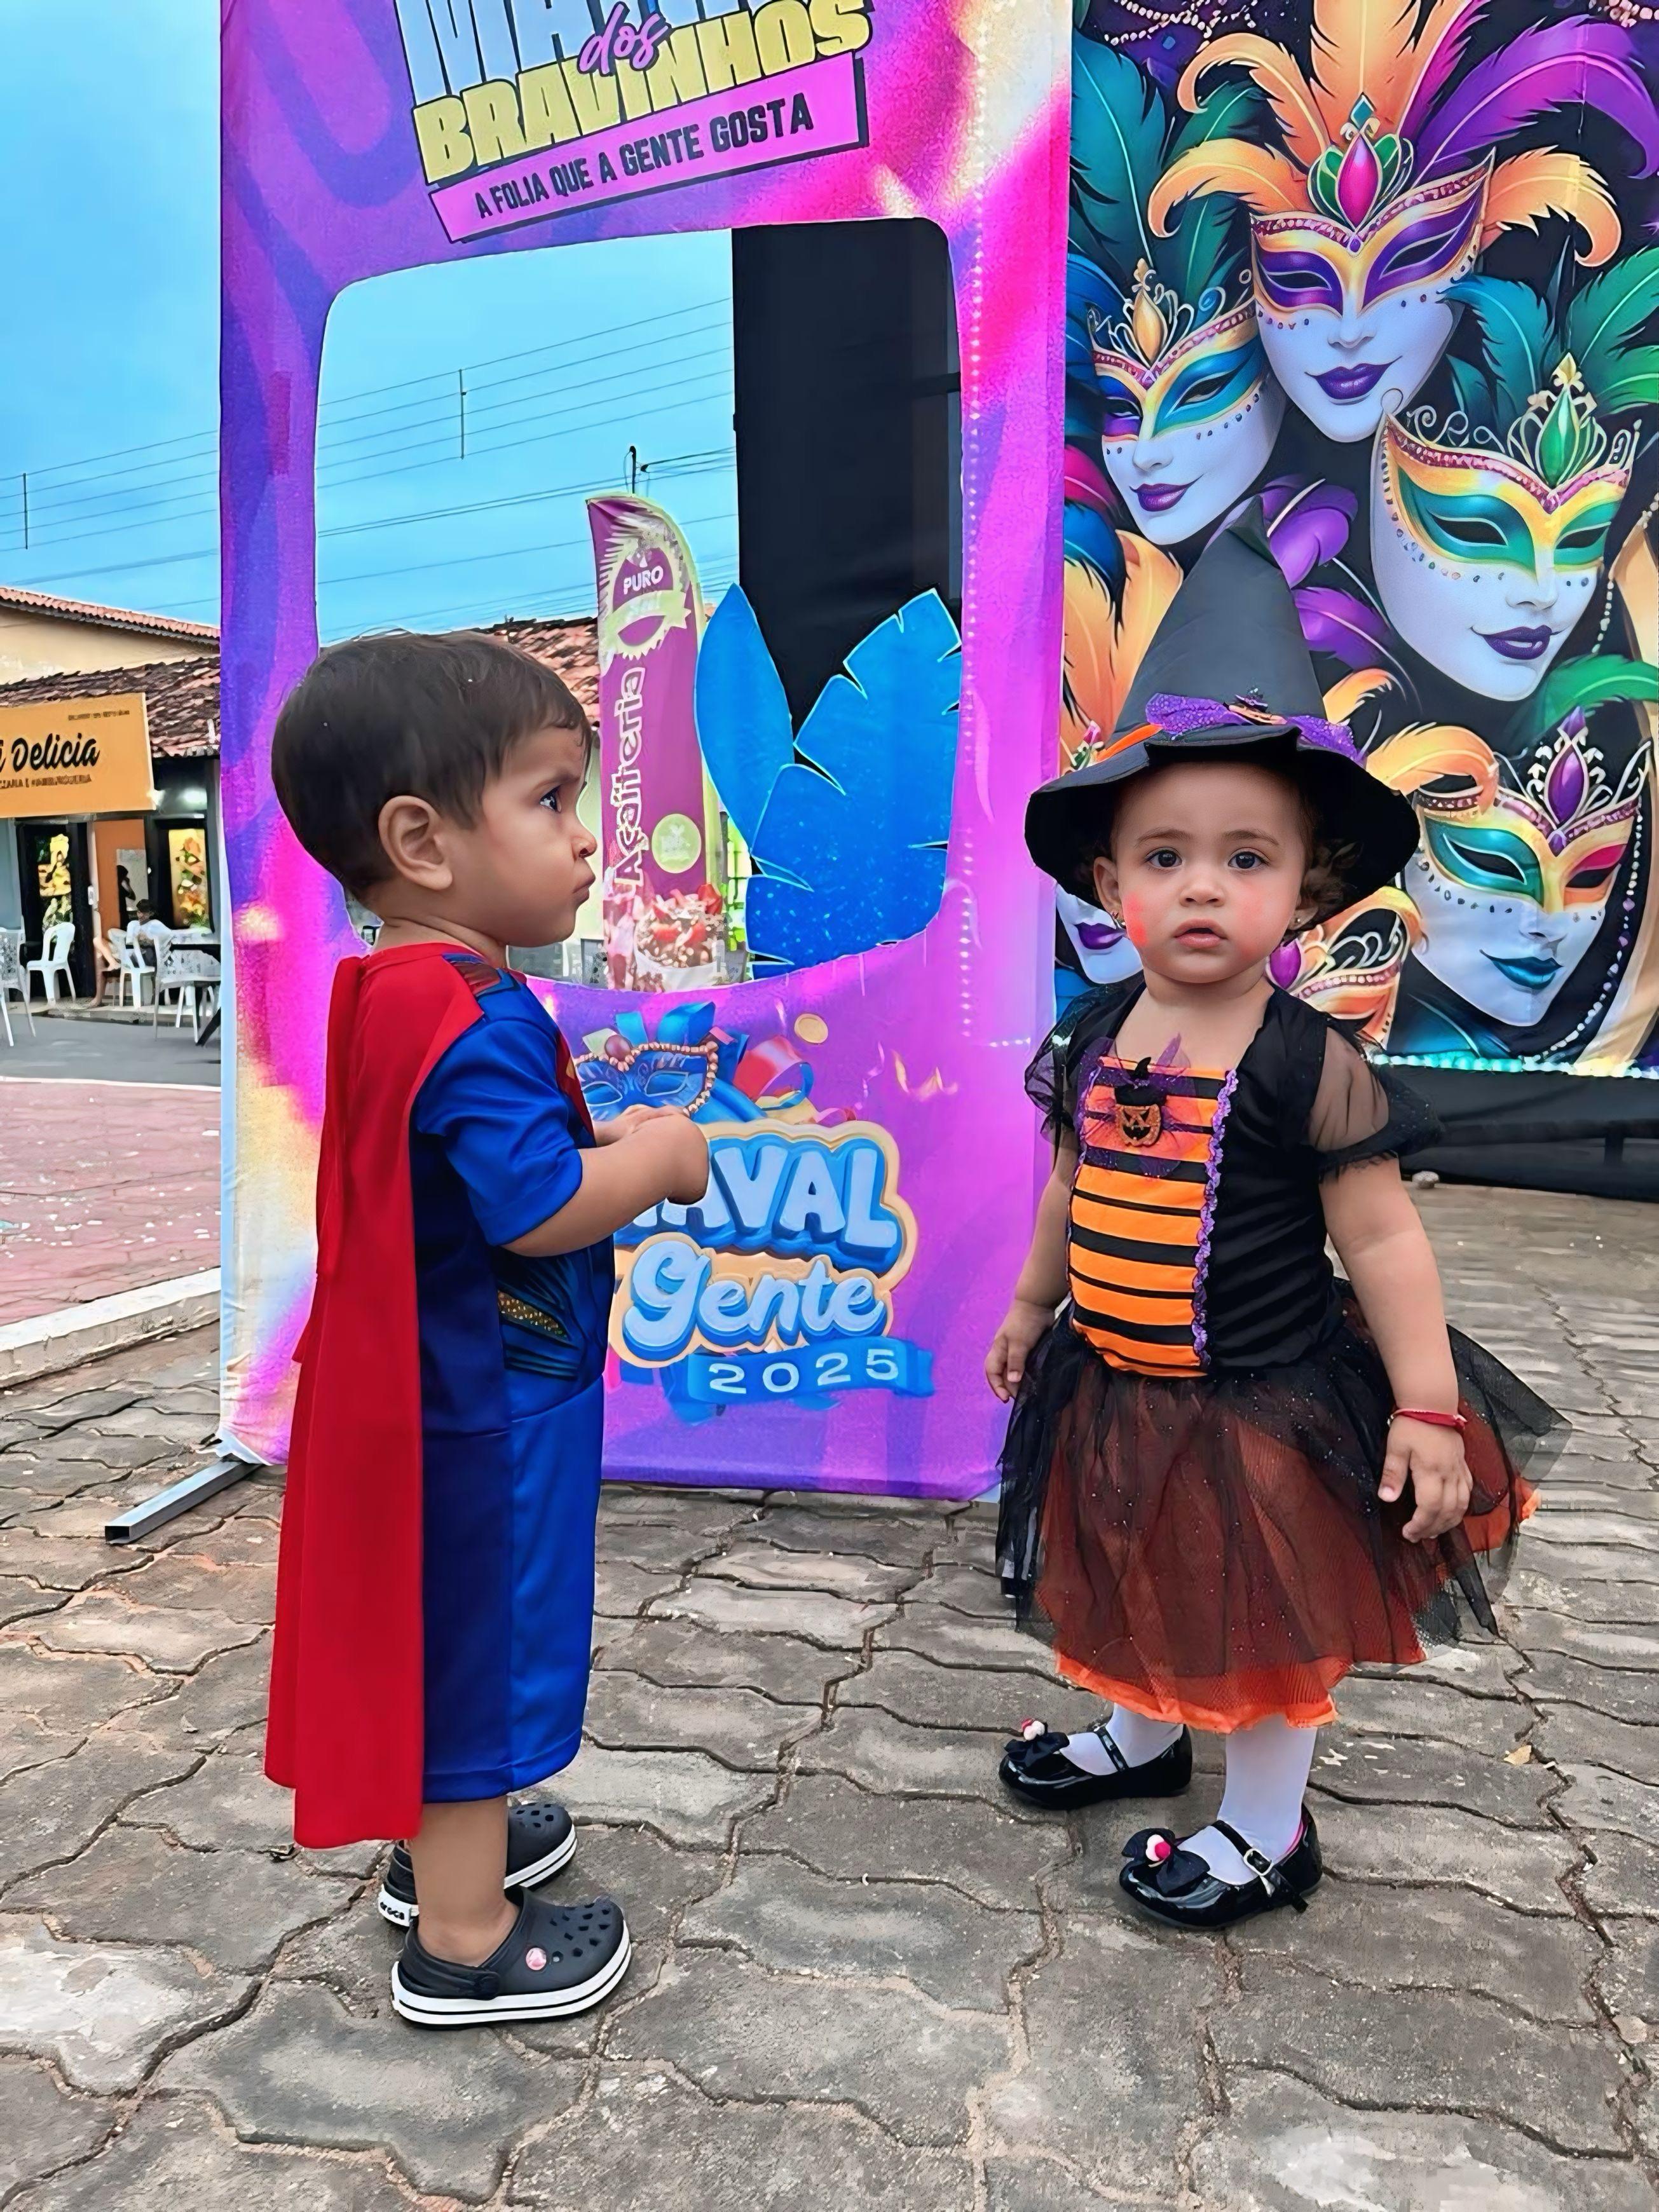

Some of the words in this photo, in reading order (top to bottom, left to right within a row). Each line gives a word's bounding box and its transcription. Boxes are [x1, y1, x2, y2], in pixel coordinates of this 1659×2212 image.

[579, 3, 669, 75] dos
[413, 0, 870, 182] BRAVINHOS
[474, 192, 493, 219] A
[489, 172, 550, 214] FOLIA
[549, 158, 594, 198] QUE
[598, 151, 618, 184] A
[619, 123, 704, 177] GENTE
[709, 92, 814, 153] GOSTA
[623, 565, 664, 595] PURO
[709, 1349, 899, 1395] 2025
